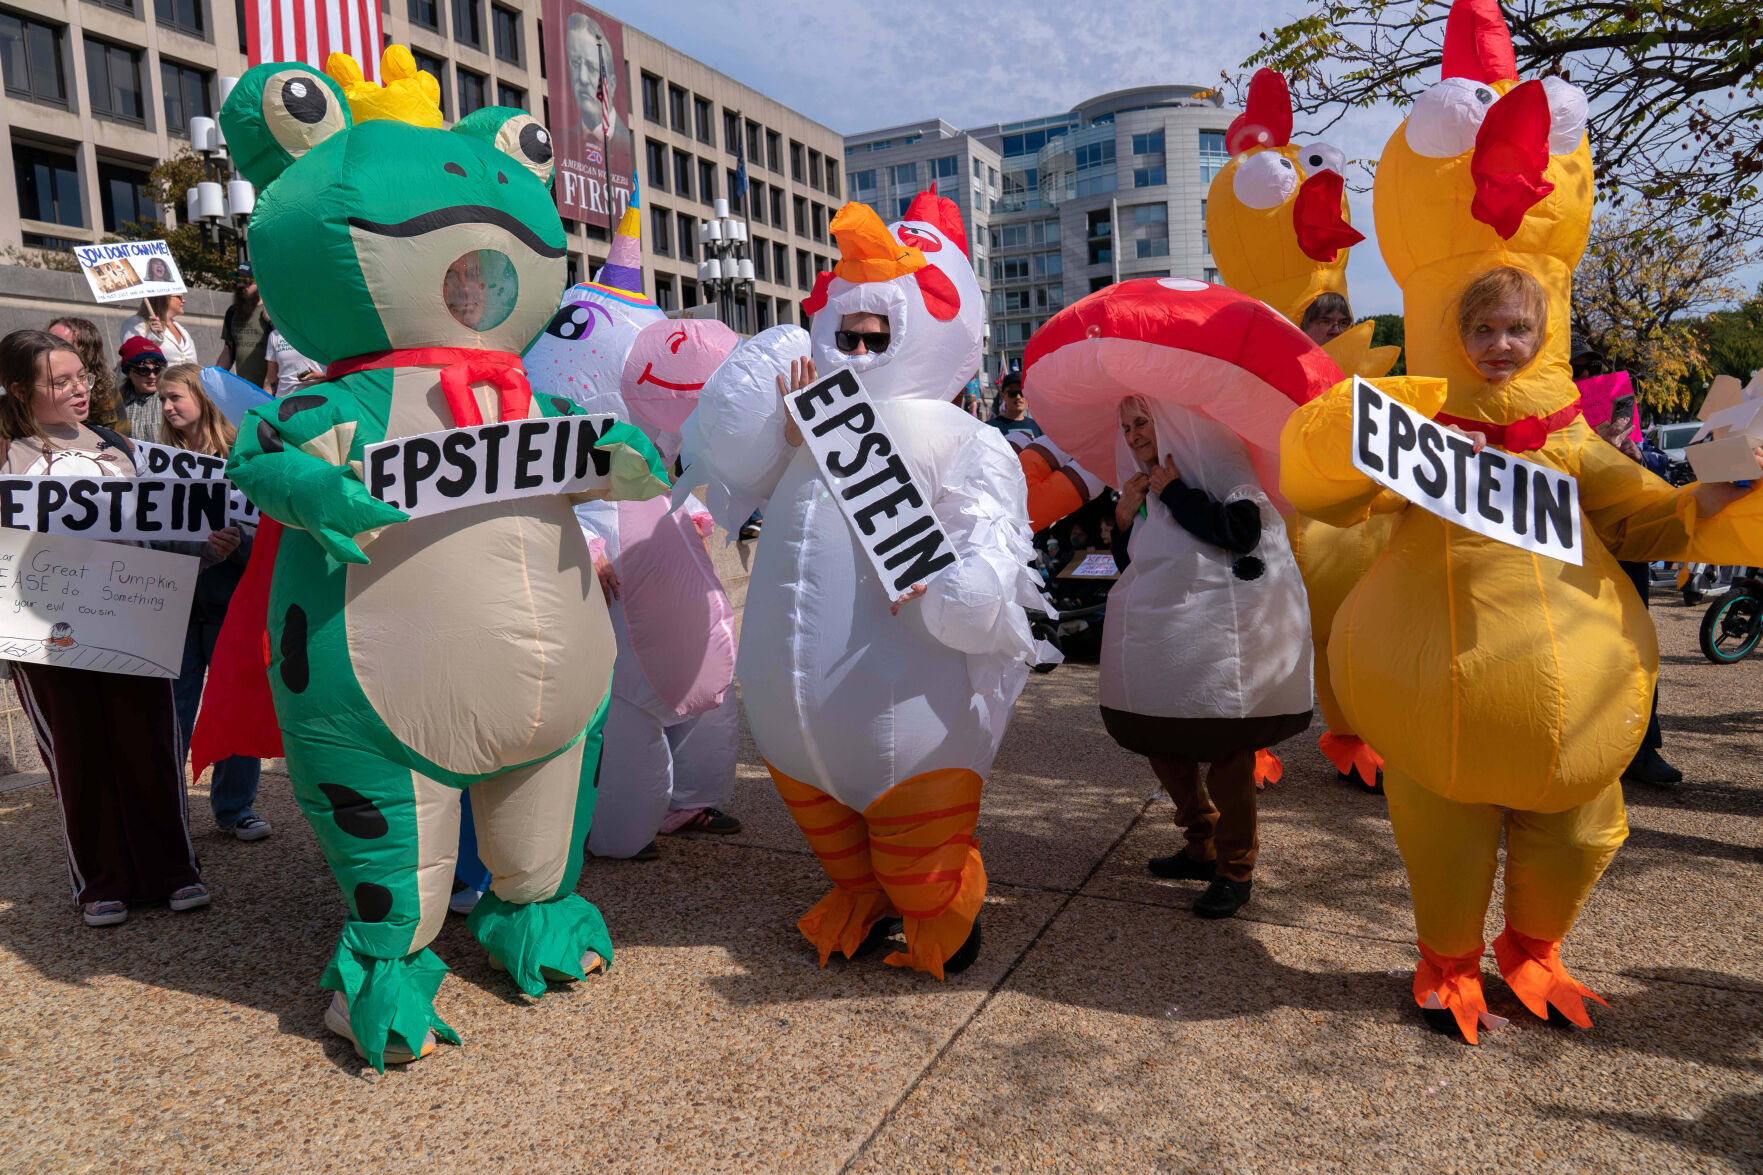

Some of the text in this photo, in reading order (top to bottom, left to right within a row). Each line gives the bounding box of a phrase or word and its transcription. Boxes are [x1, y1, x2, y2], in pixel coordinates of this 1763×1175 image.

[561, 158, 598, 176] AMERICAN
[562, 171, 630, 219] FIRST
[78, 248, 106, 268] YOU
[130, 243, 154, 256] OWN
[371, 418, 615, 509] EPSTEIN
[795, 369, 955, 591] EPSTEIN
[1358, 382, 1573, 549] EPSTEIN
[0, 480, 227, 533] EPSTEIN
[32, 549, 89, 579] Great
[13, 599, 37, 613] your
[46, 601, 65, 611] evil
[61, 581, 80, 595] do
[102, 585, 164, 612] Something
